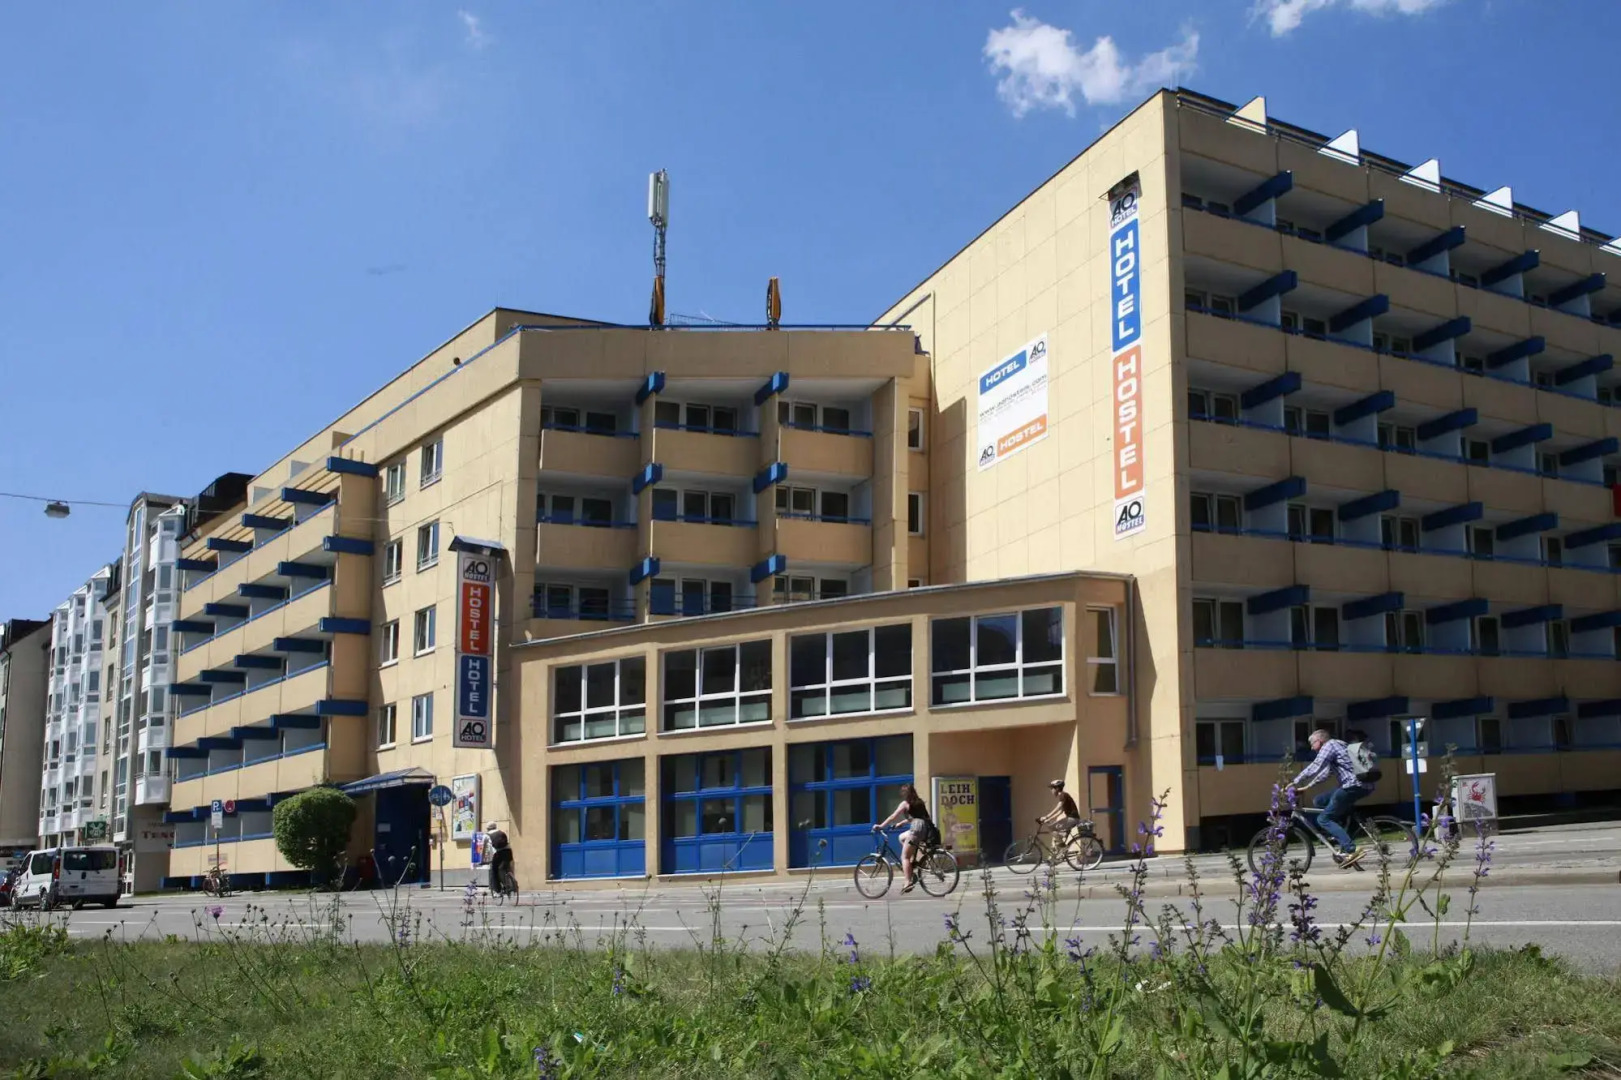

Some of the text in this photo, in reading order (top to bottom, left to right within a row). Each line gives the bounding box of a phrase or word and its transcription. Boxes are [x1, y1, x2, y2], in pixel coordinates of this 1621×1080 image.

[1111, 207, 1137, 228] HOTEL
[1115, 230, 1136, 340] HOTEL
[985, 360, 1020, 388] HOTEL
[999, 421, 1044, 451] HOSTEL
[1117, 354, 1138, 490] HOSTEL
[1116, 516, 1144, 535] HOSTEL
[468, 587, 482, 652] HOSTEL
[468, 658, 481, 714] HOTEL
[460, 733, 485, 742] HOTEL
[941, 795, 975, 805] DOCH
